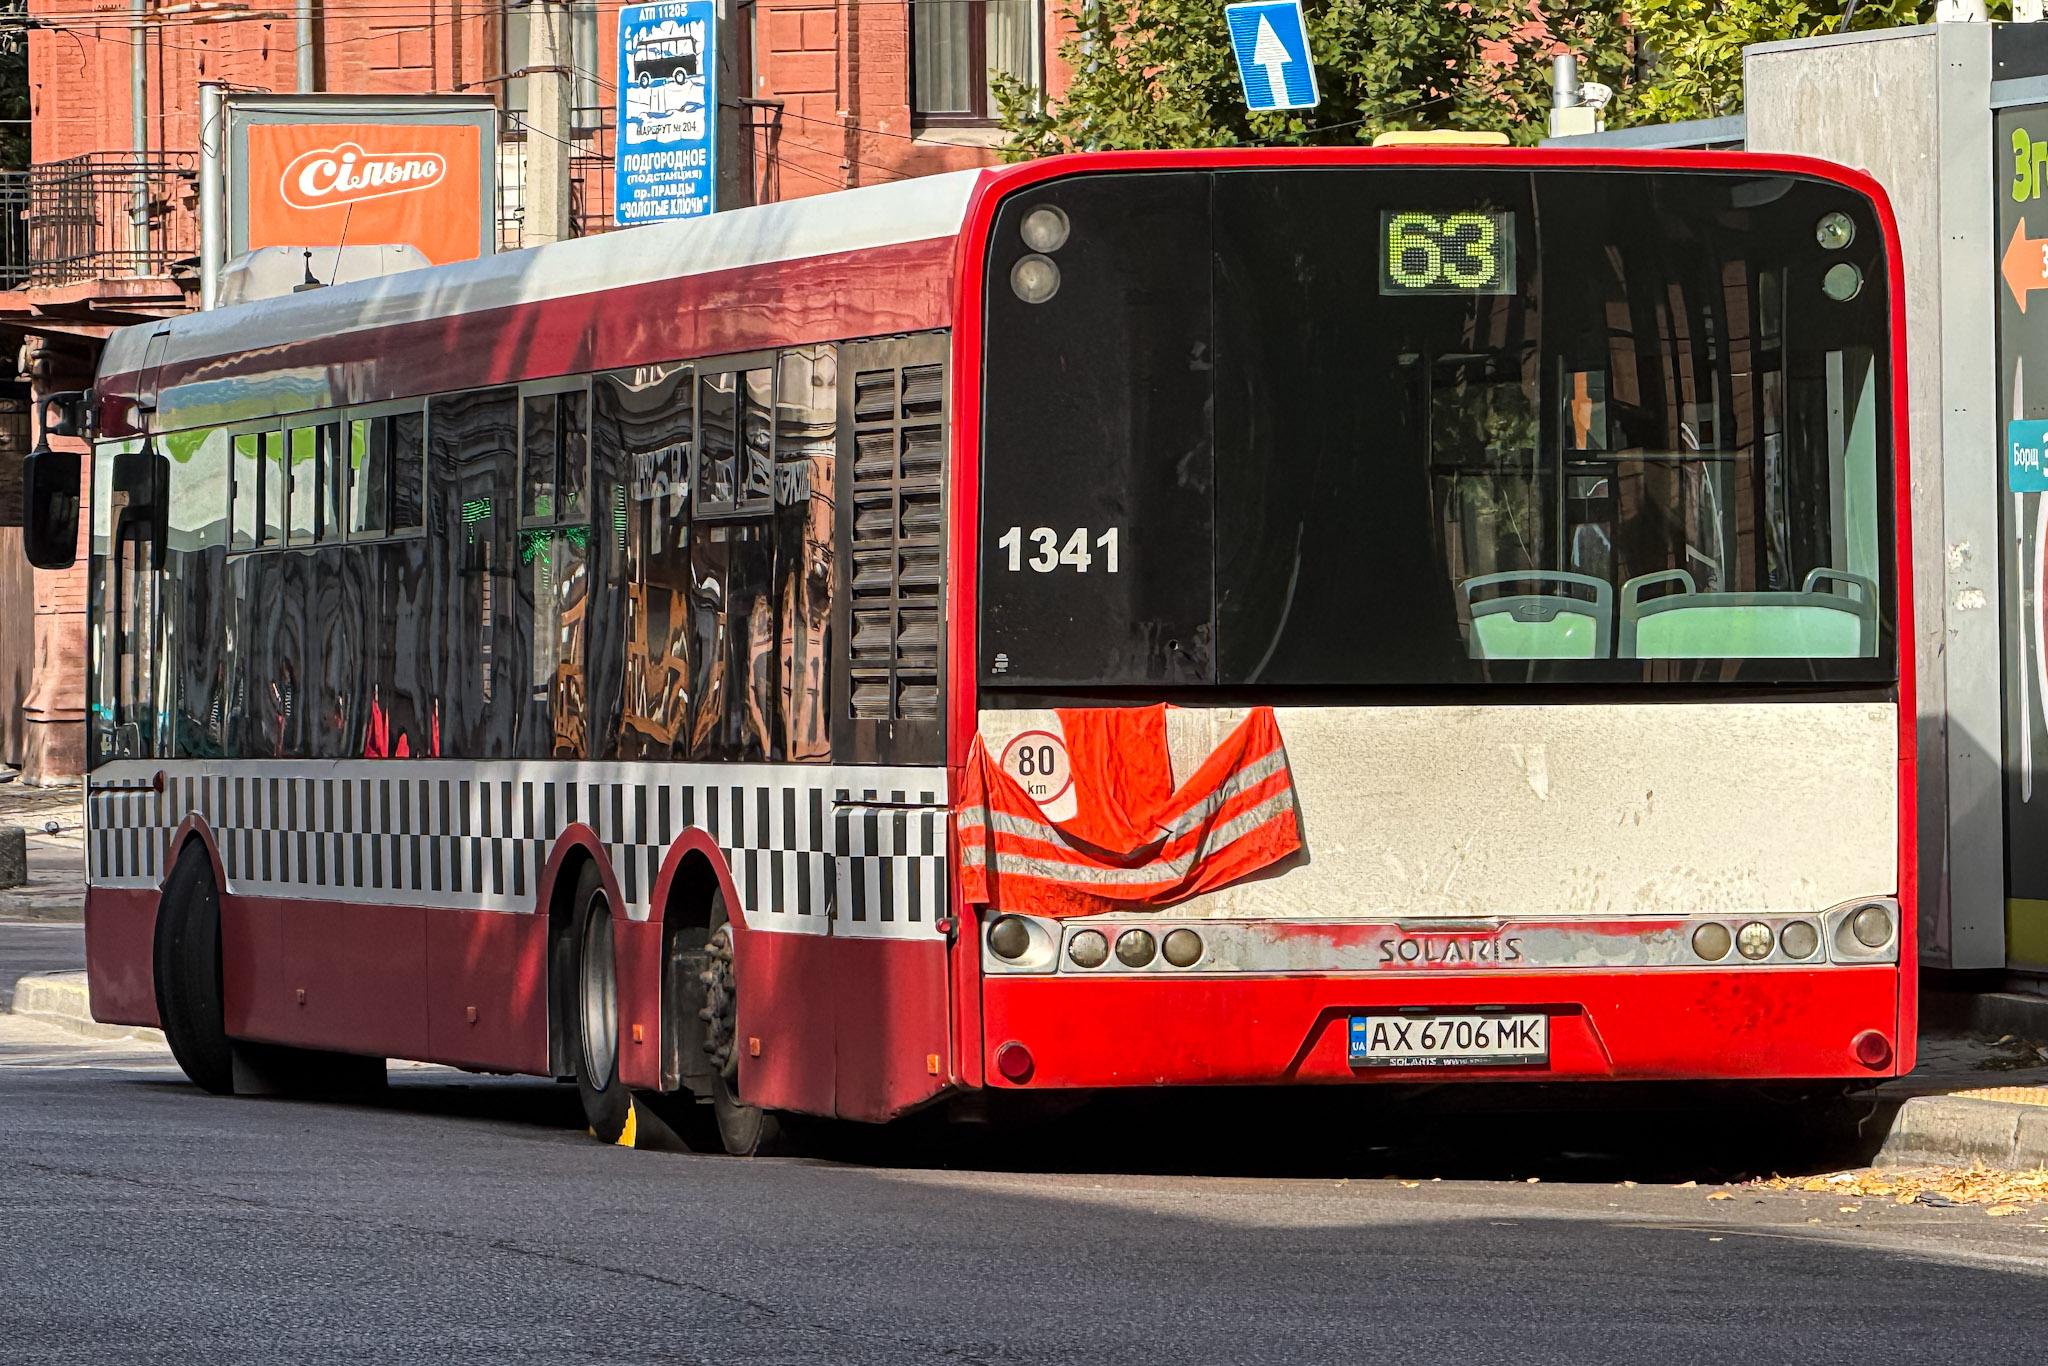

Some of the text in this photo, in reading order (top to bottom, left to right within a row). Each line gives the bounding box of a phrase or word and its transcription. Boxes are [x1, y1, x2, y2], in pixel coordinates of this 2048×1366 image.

[639, 4, 688, 21] АТП 11205
[682, 121, 697, 132] 204
[624, 148, 707, 173] ПОДГОРОДНОЕ
[299, 152, 439, 196] Сільпо
[627, 170, 702, 185] (ПОДСТАНЦИЯ)
[1389, 213, 1494, 288] 63
[2013, 442, 2039, 473] Борщ
[999, 526, 1119, 573] 1341
[1018, 745, 1055, 776] 80
[1027, 780, 1046, 795] km
[1379, 937, 1523, 963] SOLARIS
[1352, 1041, 1366, 1051] UA
[1389, 1057, 1437, 1067] SOLARIS
